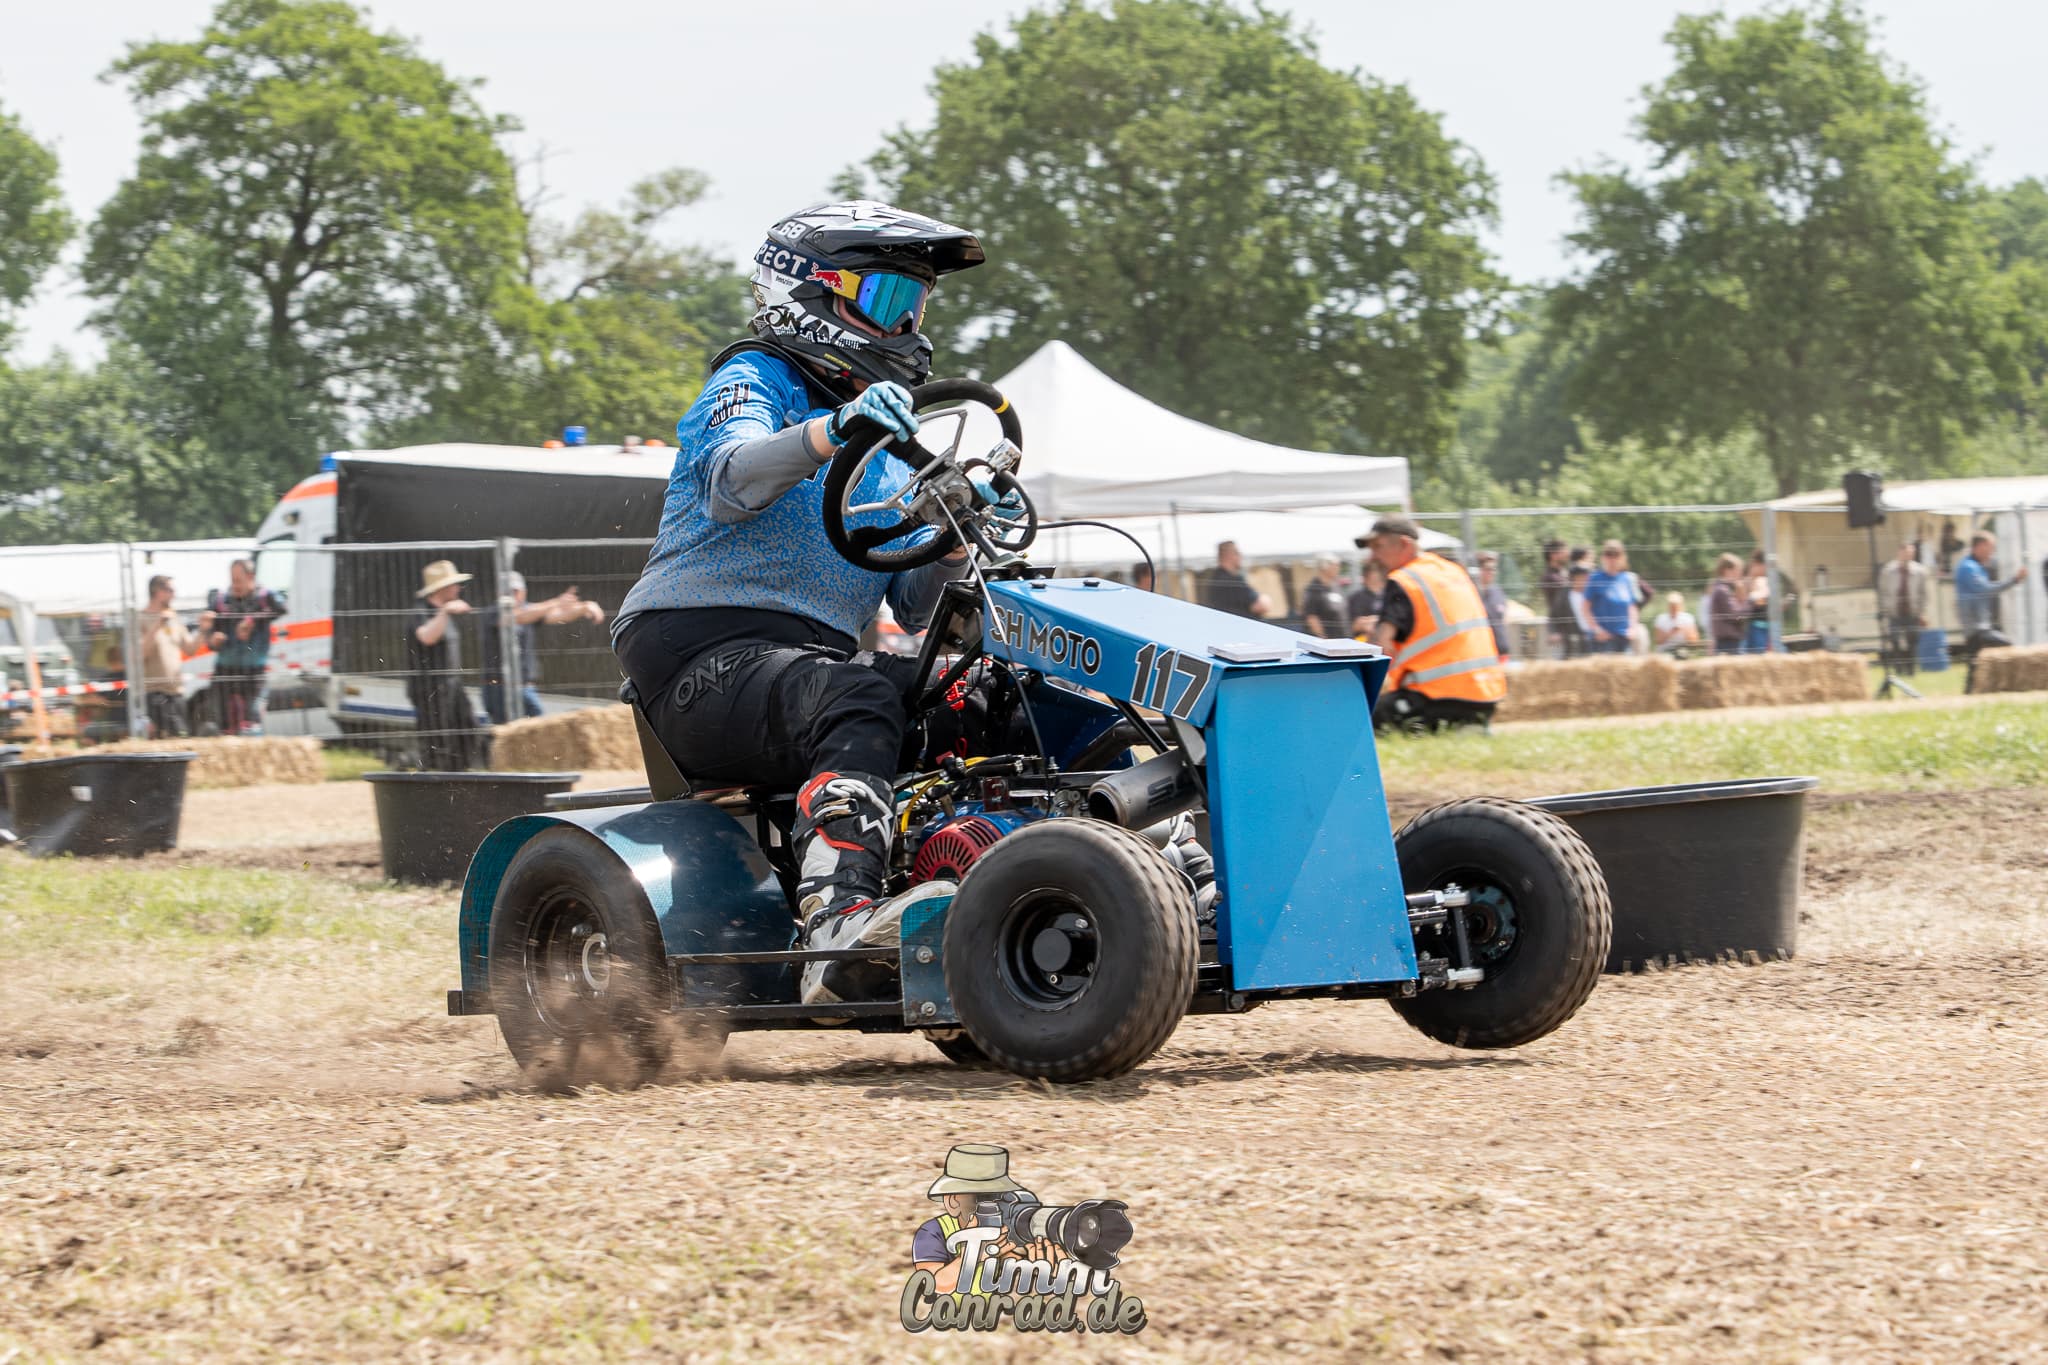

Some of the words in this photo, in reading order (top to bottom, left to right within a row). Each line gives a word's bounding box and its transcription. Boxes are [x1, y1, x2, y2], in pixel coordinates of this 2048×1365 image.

[989, 604, 1025, 650] SH
[1028, 616, 1102, 677] MOTO
[1129, 641, 1213, 720] 117
